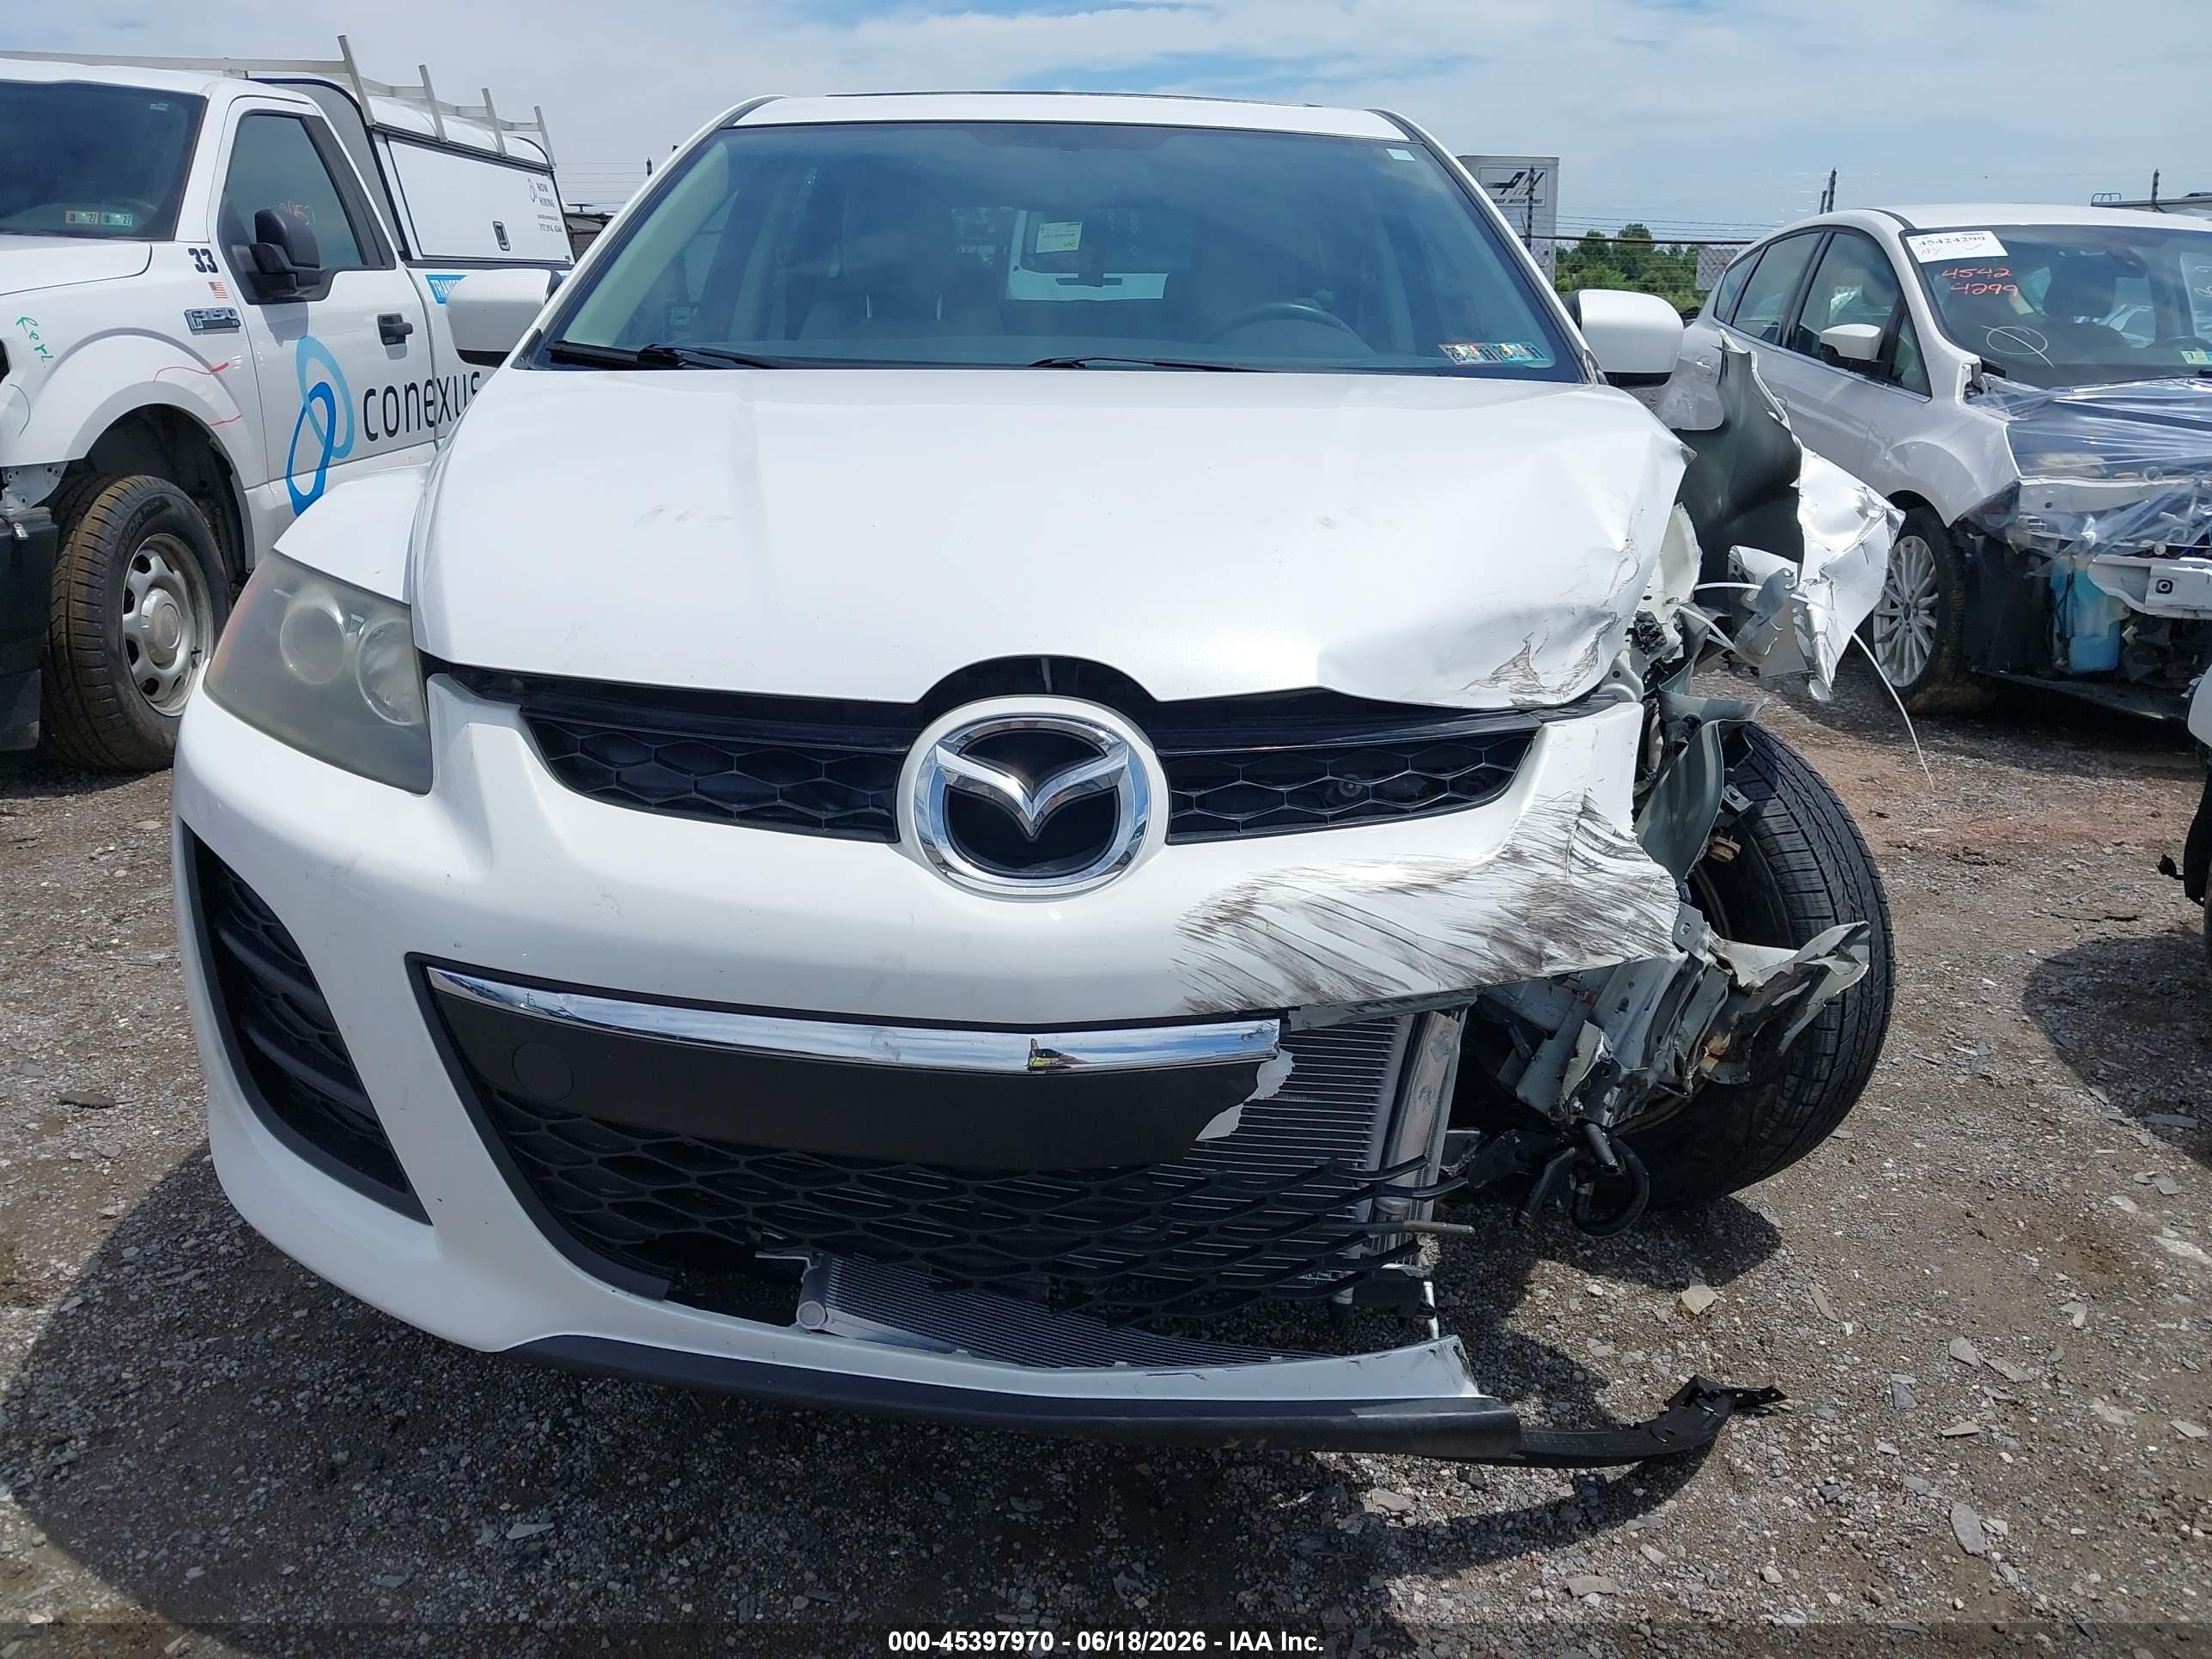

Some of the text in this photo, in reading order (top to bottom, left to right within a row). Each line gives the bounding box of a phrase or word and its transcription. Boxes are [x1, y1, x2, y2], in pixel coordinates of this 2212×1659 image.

[187, 247, 219, 273] 33
[1942, 268, 2013, 279] 4542
[1950, 282, 2019, 297] 4299
